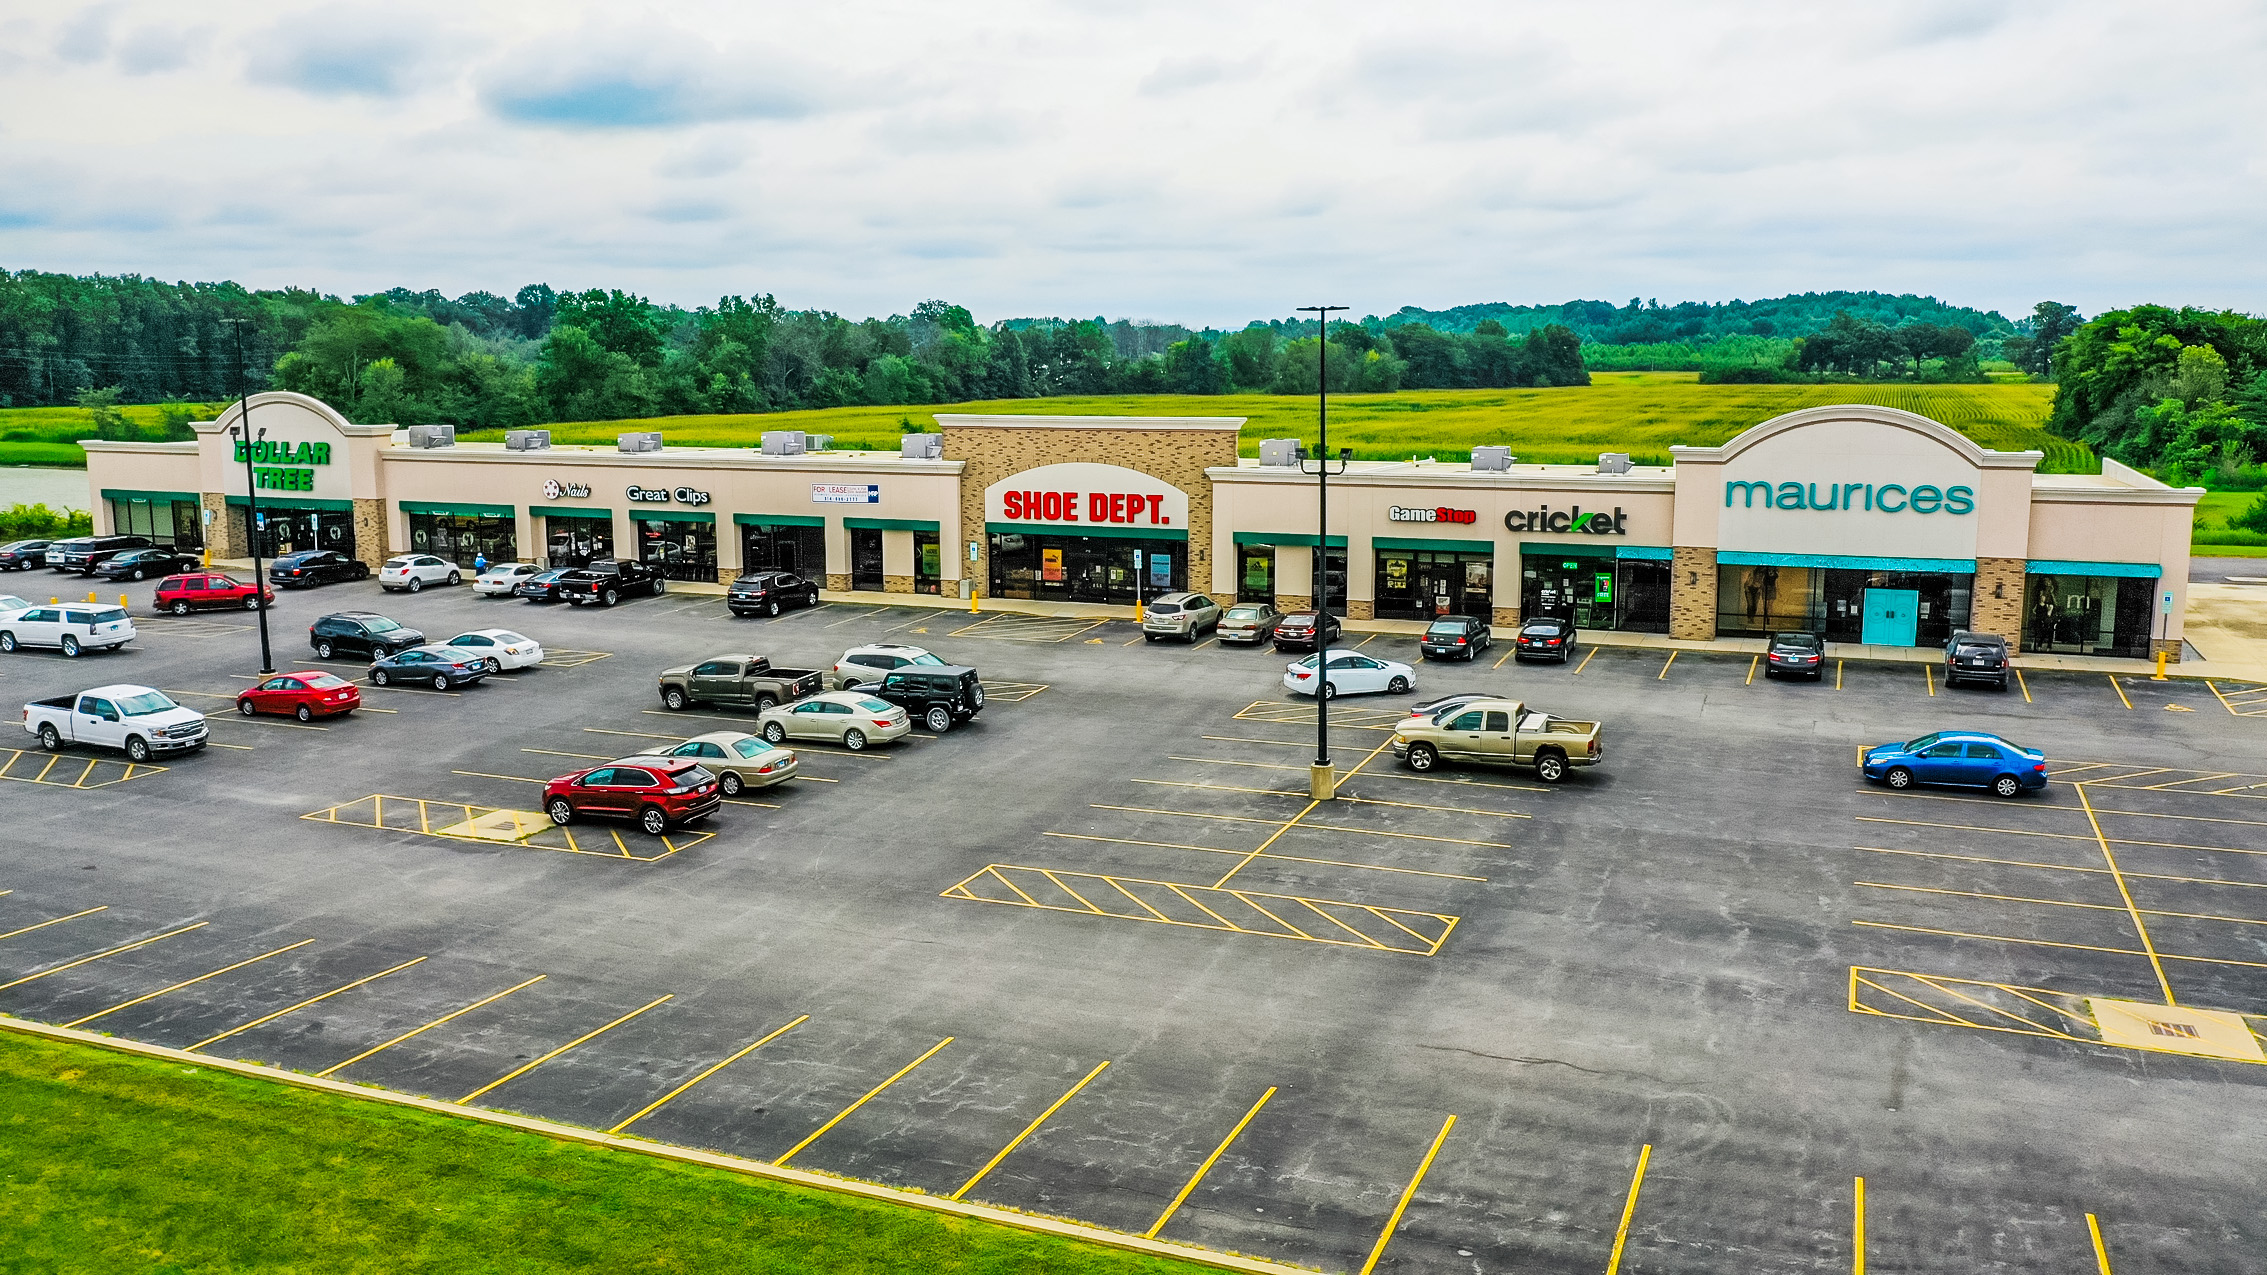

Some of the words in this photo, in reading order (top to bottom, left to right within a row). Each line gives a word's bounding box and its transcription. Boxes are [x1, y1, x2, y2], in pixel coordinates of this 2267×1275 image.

[234, 440, 330, 465] DOLLAR
[253, 467, 314, 491] TREE
[559, 483, 590, 498] Nails
[829, 486, 848, 494] LEASE
[626, 485, 669, 501] Great
[674, 486, 710, 506] Clips
[1004, 491, 1078, 521] SHOE
[1089, 492, 1170, 524] DEPT.
[1726, 480, 1974, 515] maurices
[1389, 505, 1476, 524] GameStop
[1504, 504, 1628, 535] cricket
